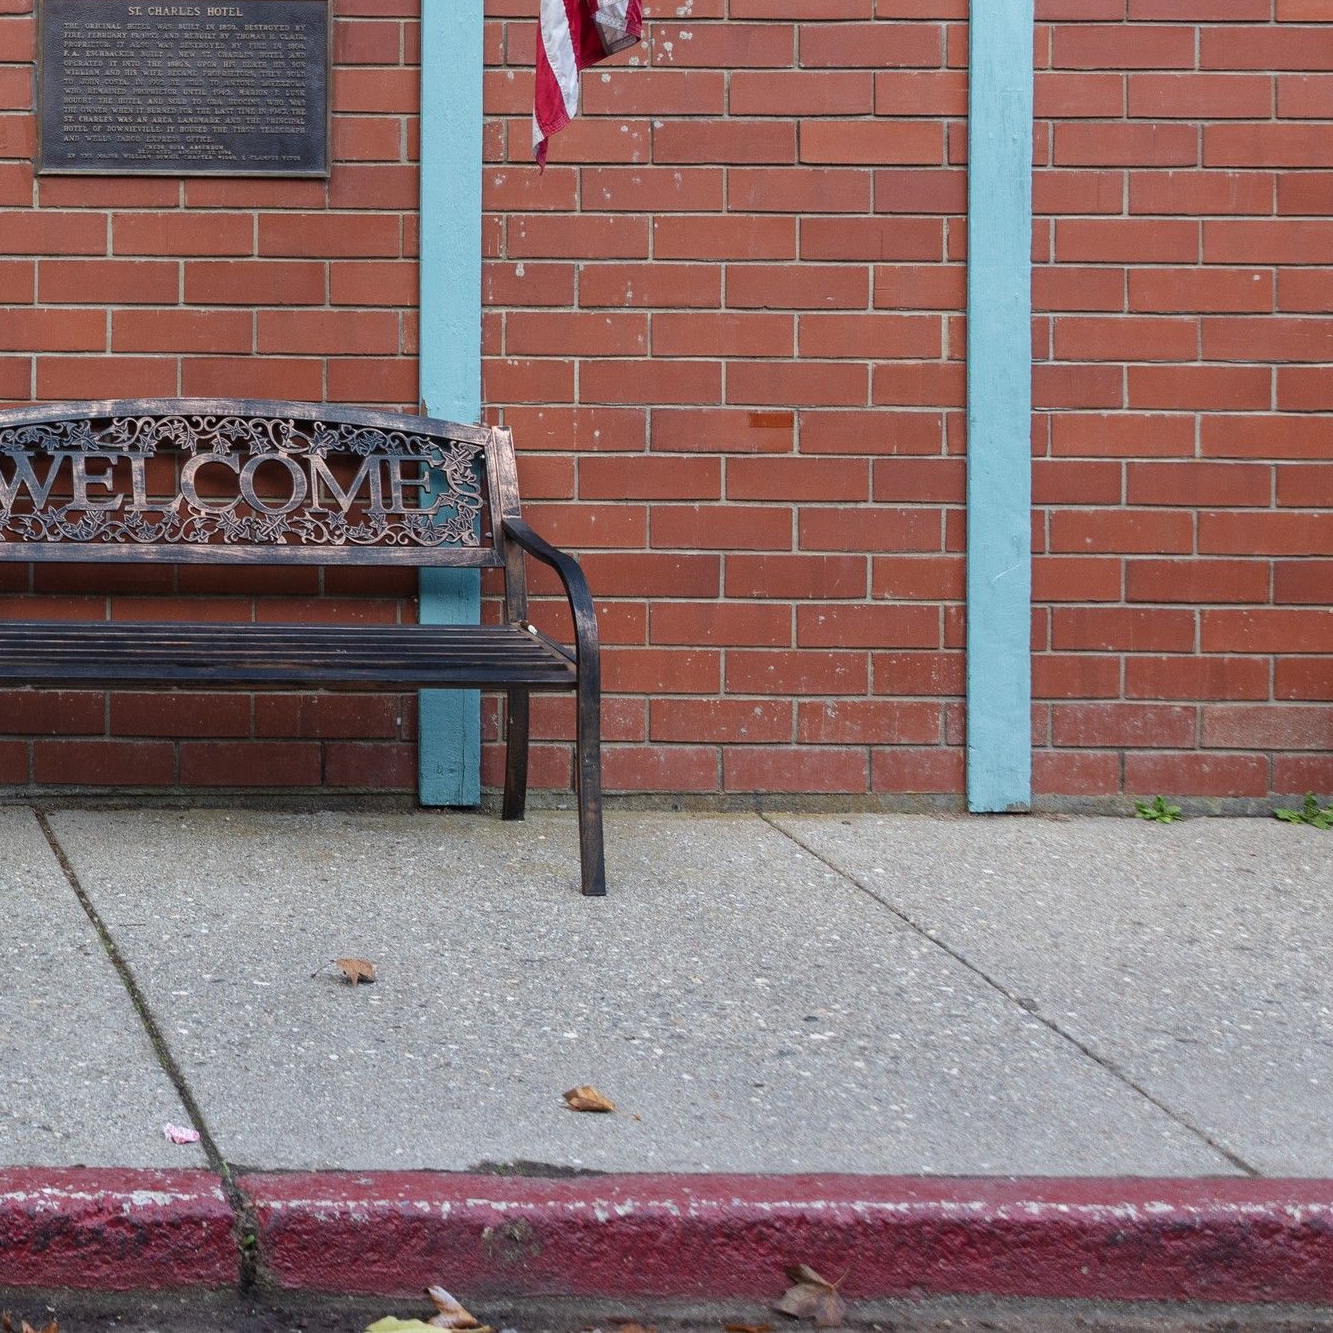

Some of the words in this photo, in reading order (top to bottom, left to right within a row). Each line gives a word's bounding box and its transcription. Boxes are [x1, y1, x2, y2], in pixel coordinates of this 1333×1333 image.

[128, 6, 142, 15] ST.
[147, 6, 201, 16] CHARLES
[207, 7, 243, 16] HOTEL
[177, 116, 220, 124] LANDMARK
[266, 117, 305, 125] PRINCIPAL
